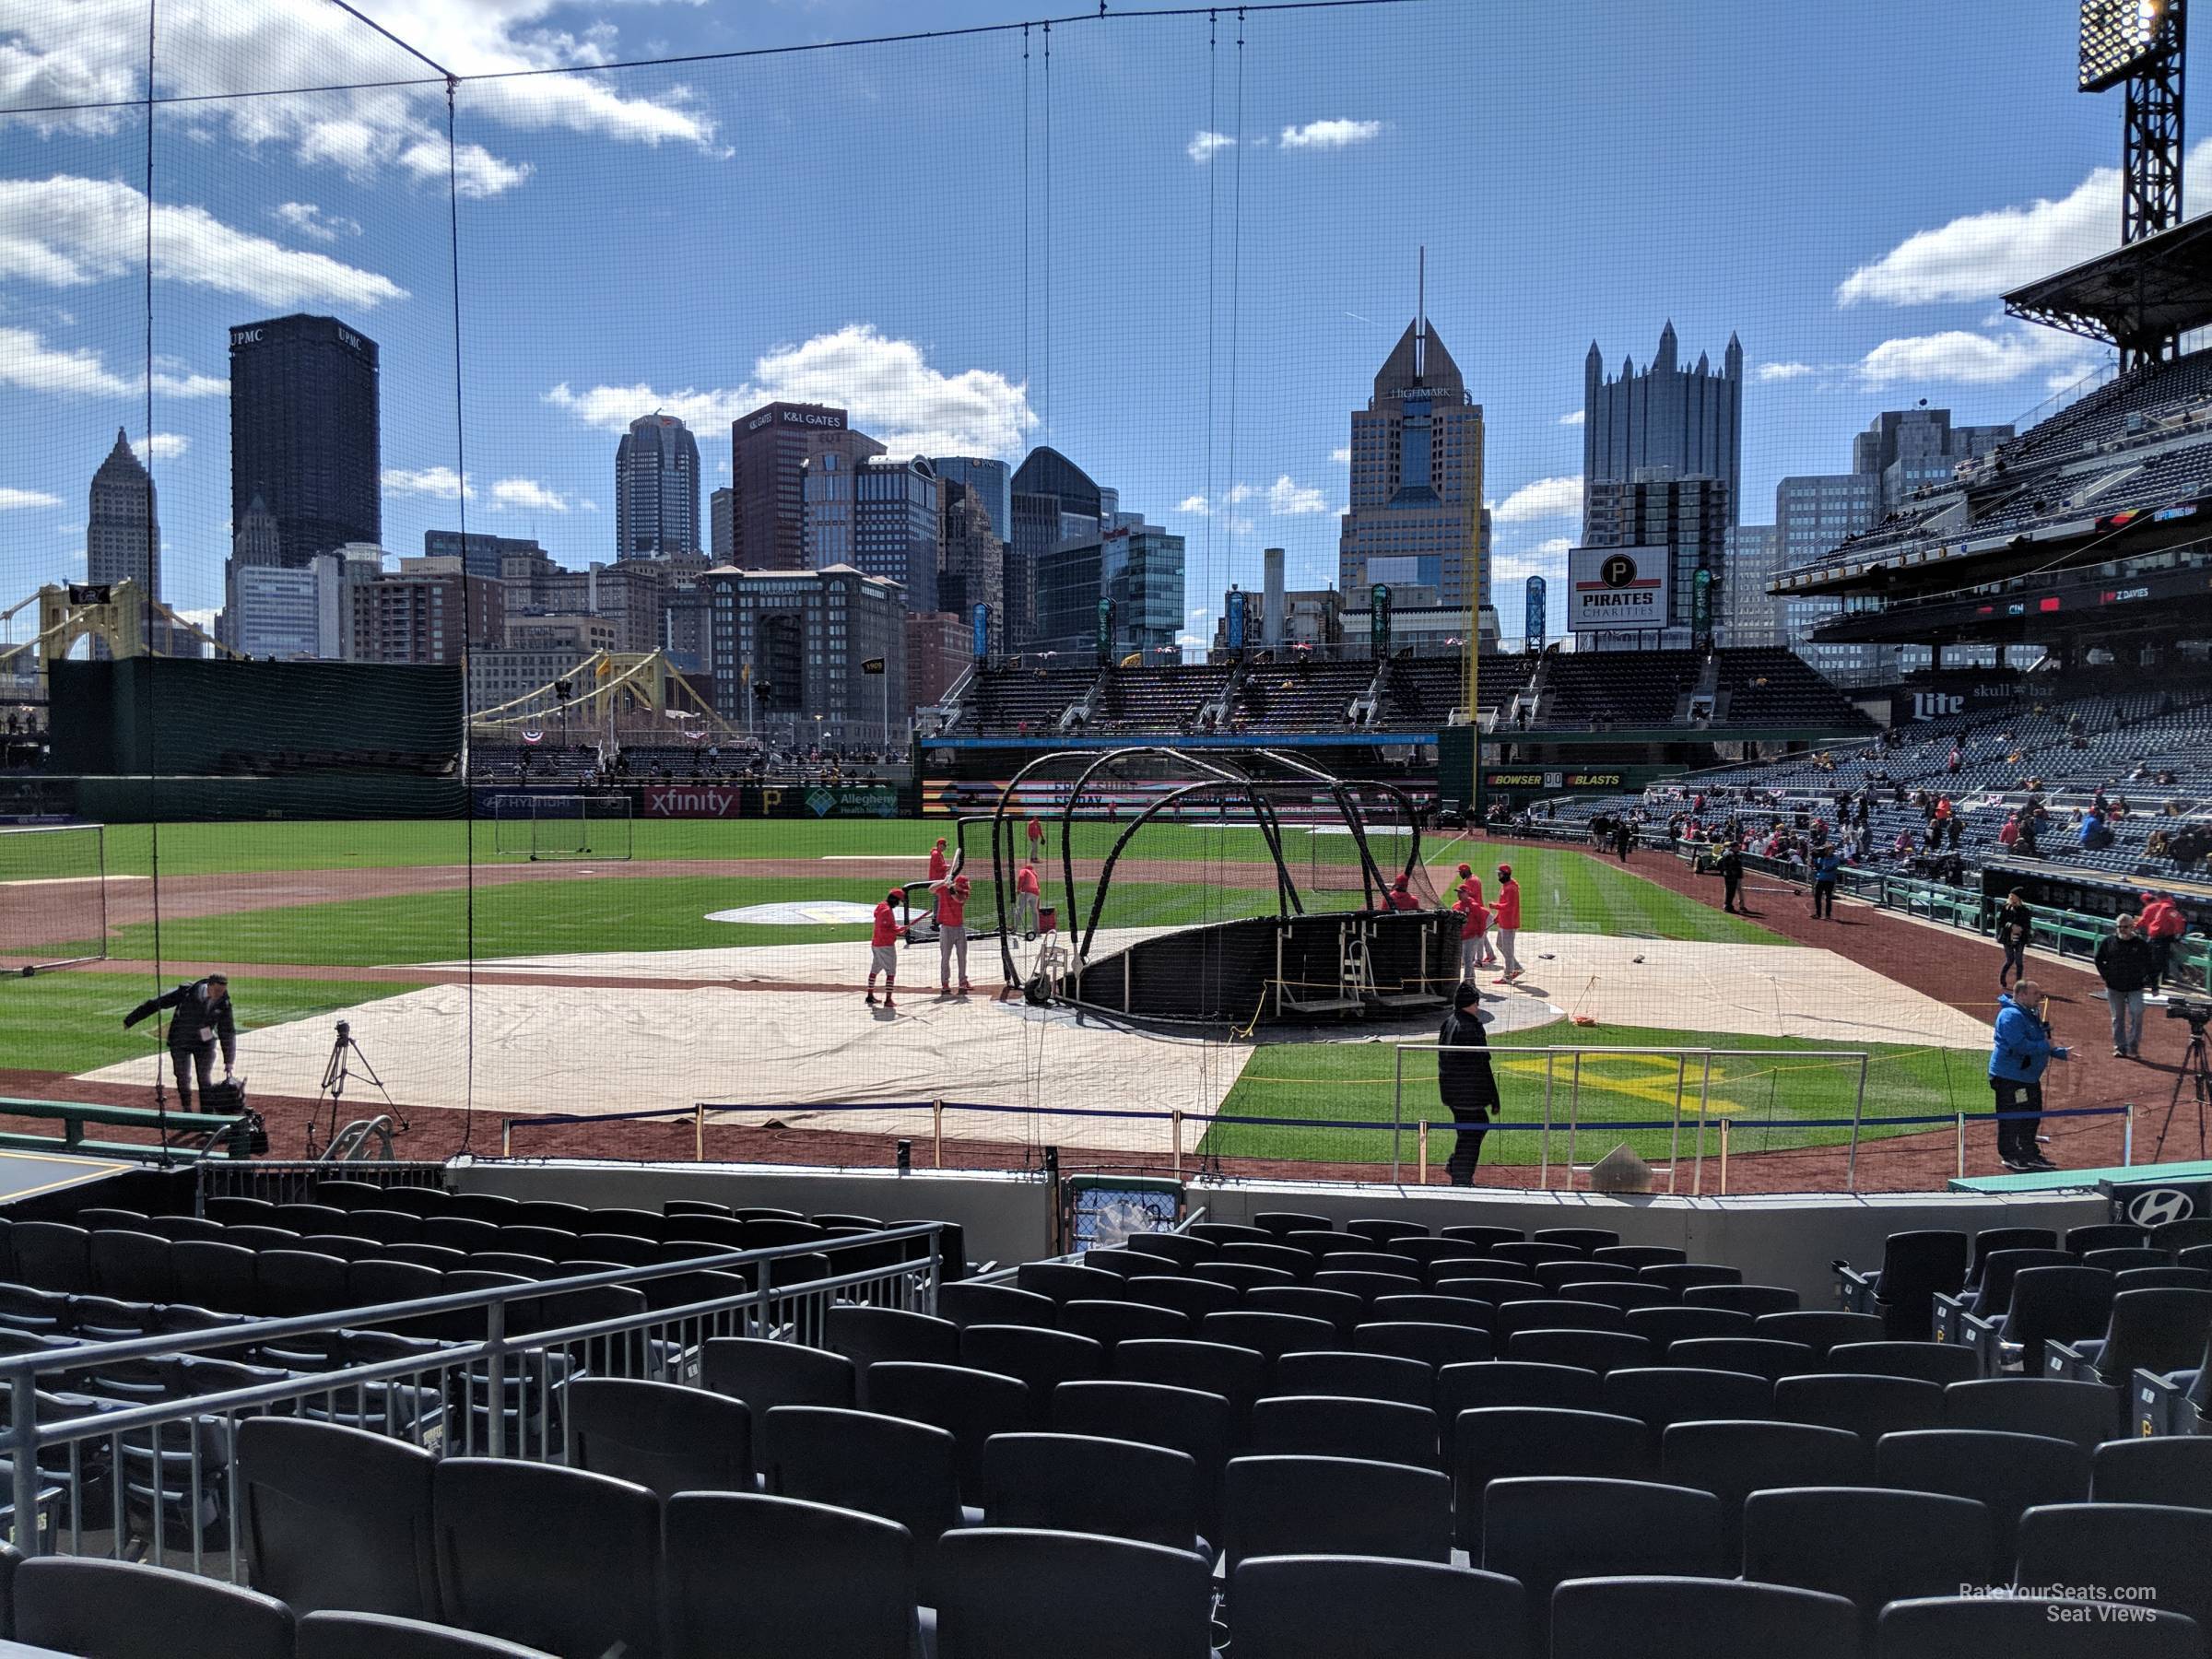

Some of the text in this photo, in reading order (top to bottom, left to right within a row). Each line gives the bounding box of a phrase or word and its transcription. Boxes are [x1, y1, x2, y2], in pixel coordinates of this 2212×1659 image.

[230, 329, 264, 347] UPMC
[338, 327, 362, 351] UPMC
[783, 411, 841, 428] K&L GATES
[1612, 561, 1627, 582] P
[1583, 593, 1653, 606] PIRATES
[2124, 588, 2148, 598] DAVIES
[1583, 606, 1653, 618] CHARITIES
[1972, 683, 2055, 697] skull bar
[1912, 693, 1965, 722] Lite
[1495, 775, 1542, 784] BOWSER
[1575, 775, 1620, 784] BLASTS
[652, 789, 734, 816] xfinity
[841, 794, 898, 806] Allegheny
